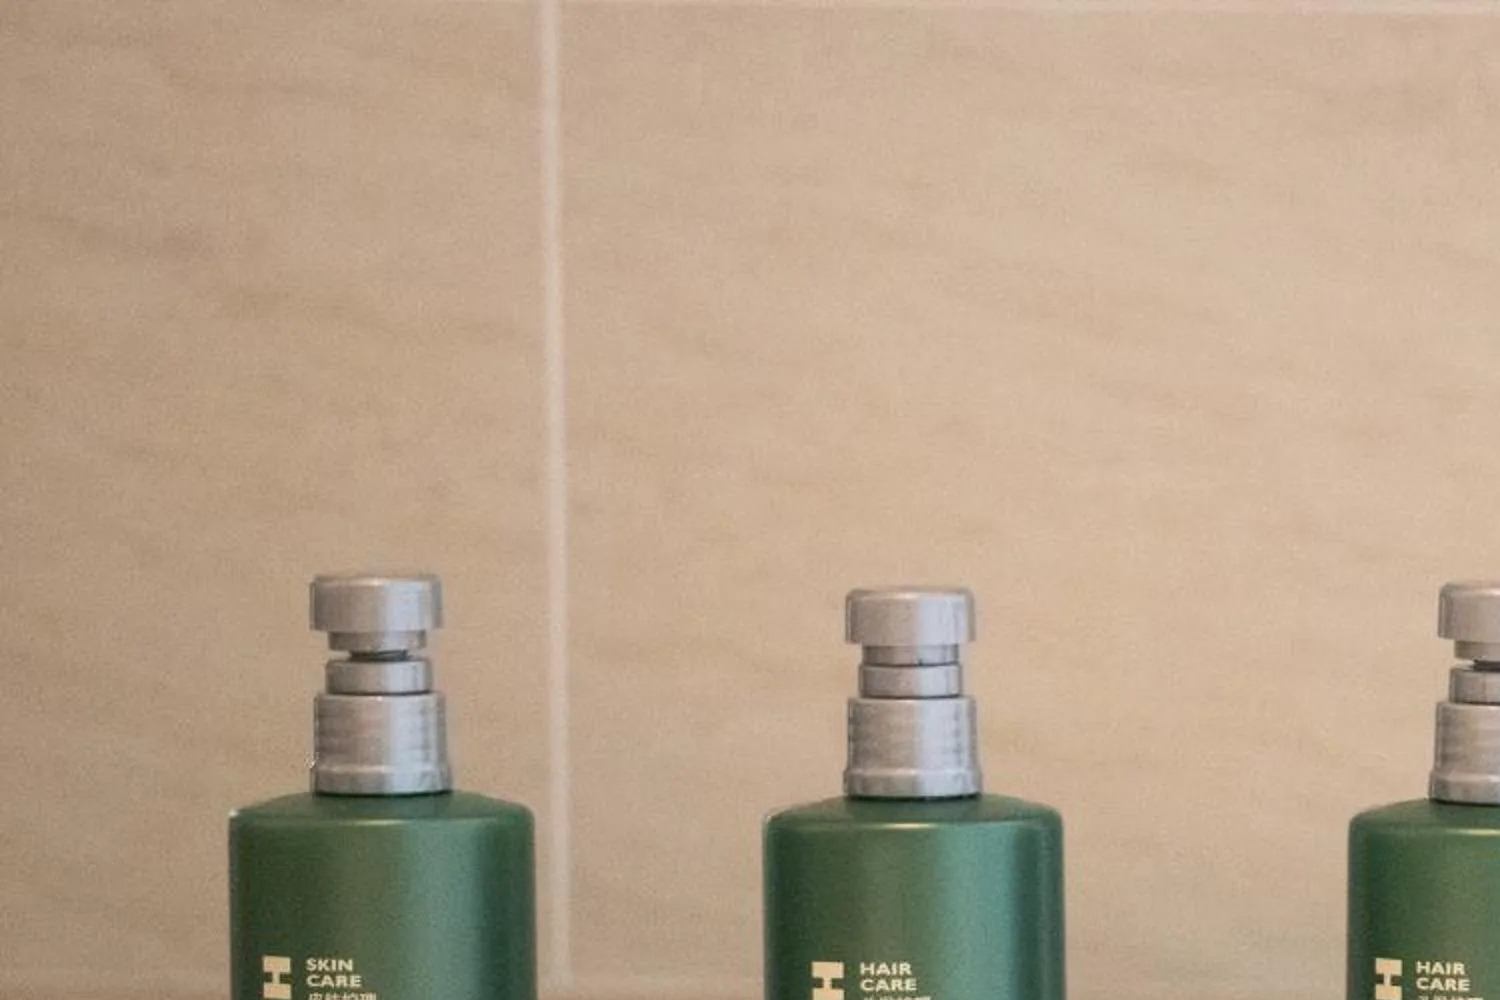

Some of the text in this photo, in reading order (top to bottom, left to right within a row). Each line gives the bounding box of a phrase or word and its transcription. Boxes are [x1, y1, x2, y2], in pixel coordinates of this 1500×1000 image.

[306, 959, 353, 972] SKIN
[860, 962, 912, 975] HAIR
[1416, 961, 1465, 975] HAIR
[306, 974, 362, 988] CARE
[860, 978, 918, 991] CARE
[1416, 978, 1470, 991] CARE
